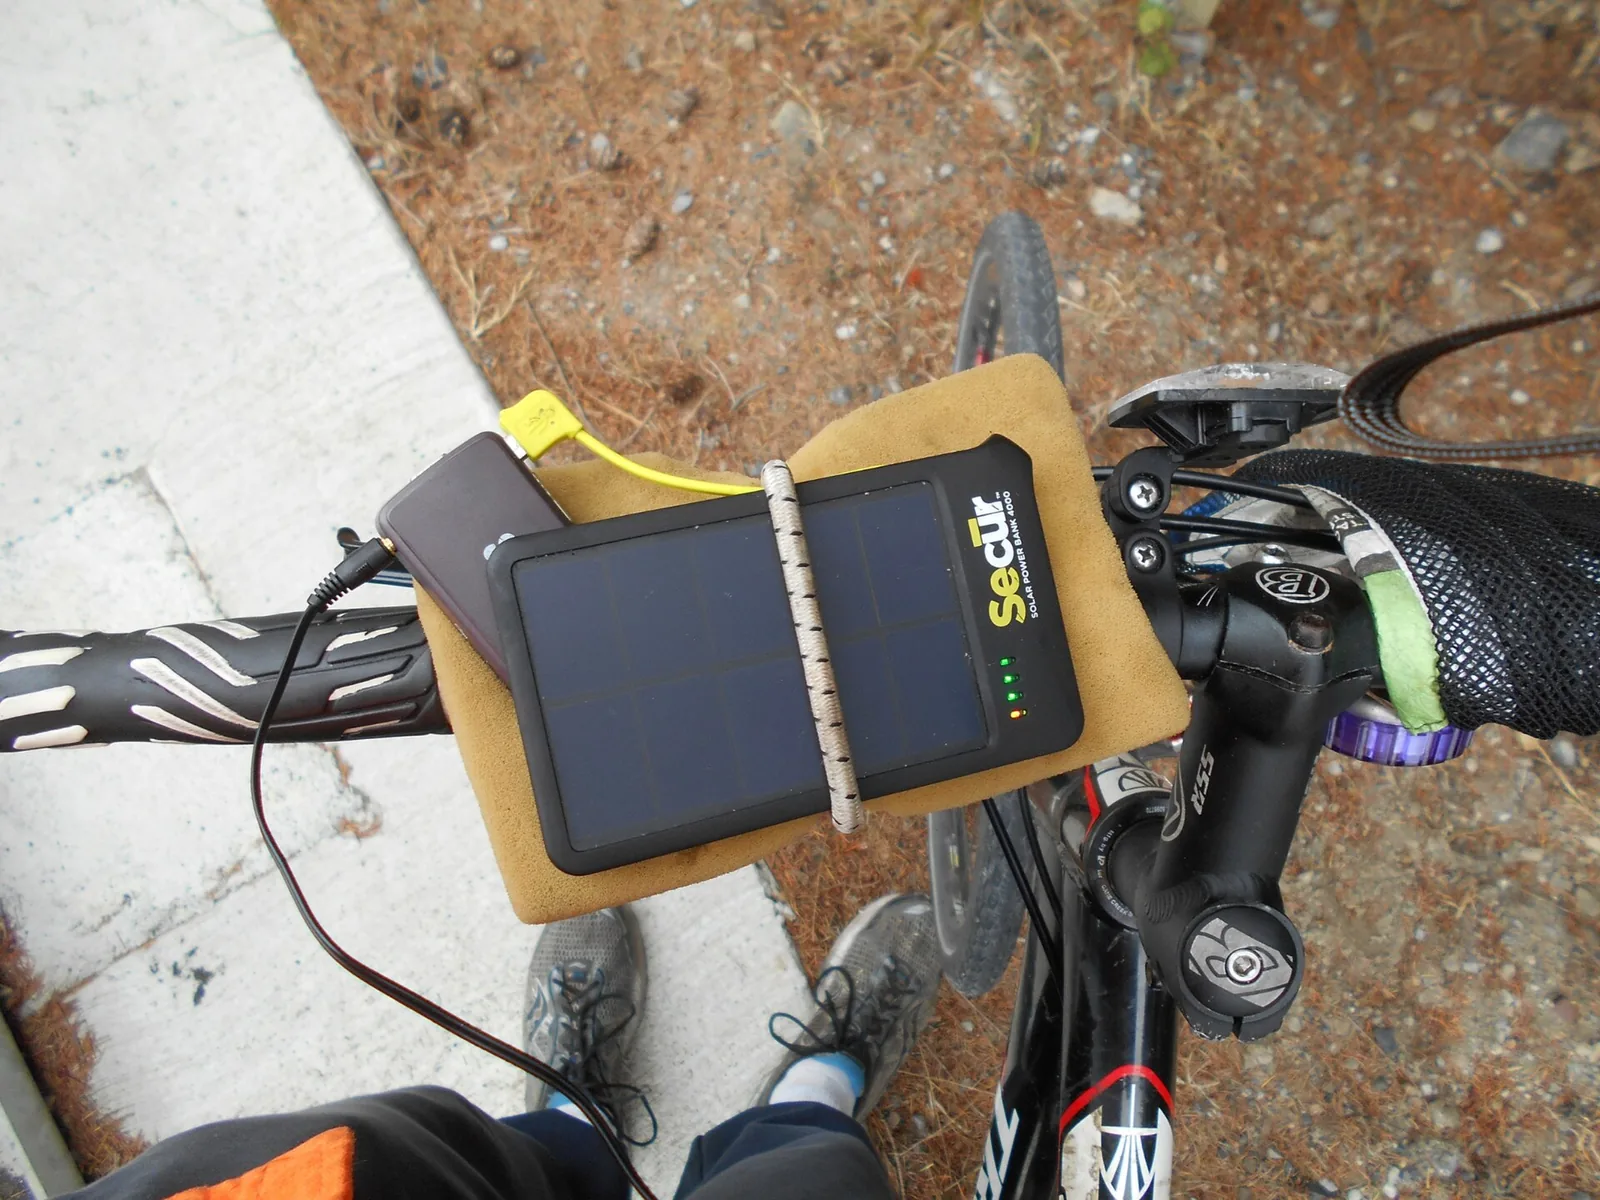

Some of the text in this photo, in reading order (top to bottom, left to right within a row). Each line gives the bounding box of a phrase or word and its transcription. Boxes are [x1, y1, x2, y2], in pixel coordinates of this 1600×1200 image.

[1002, 490, 1039, 619] SOLAR POWER BANK 4000
